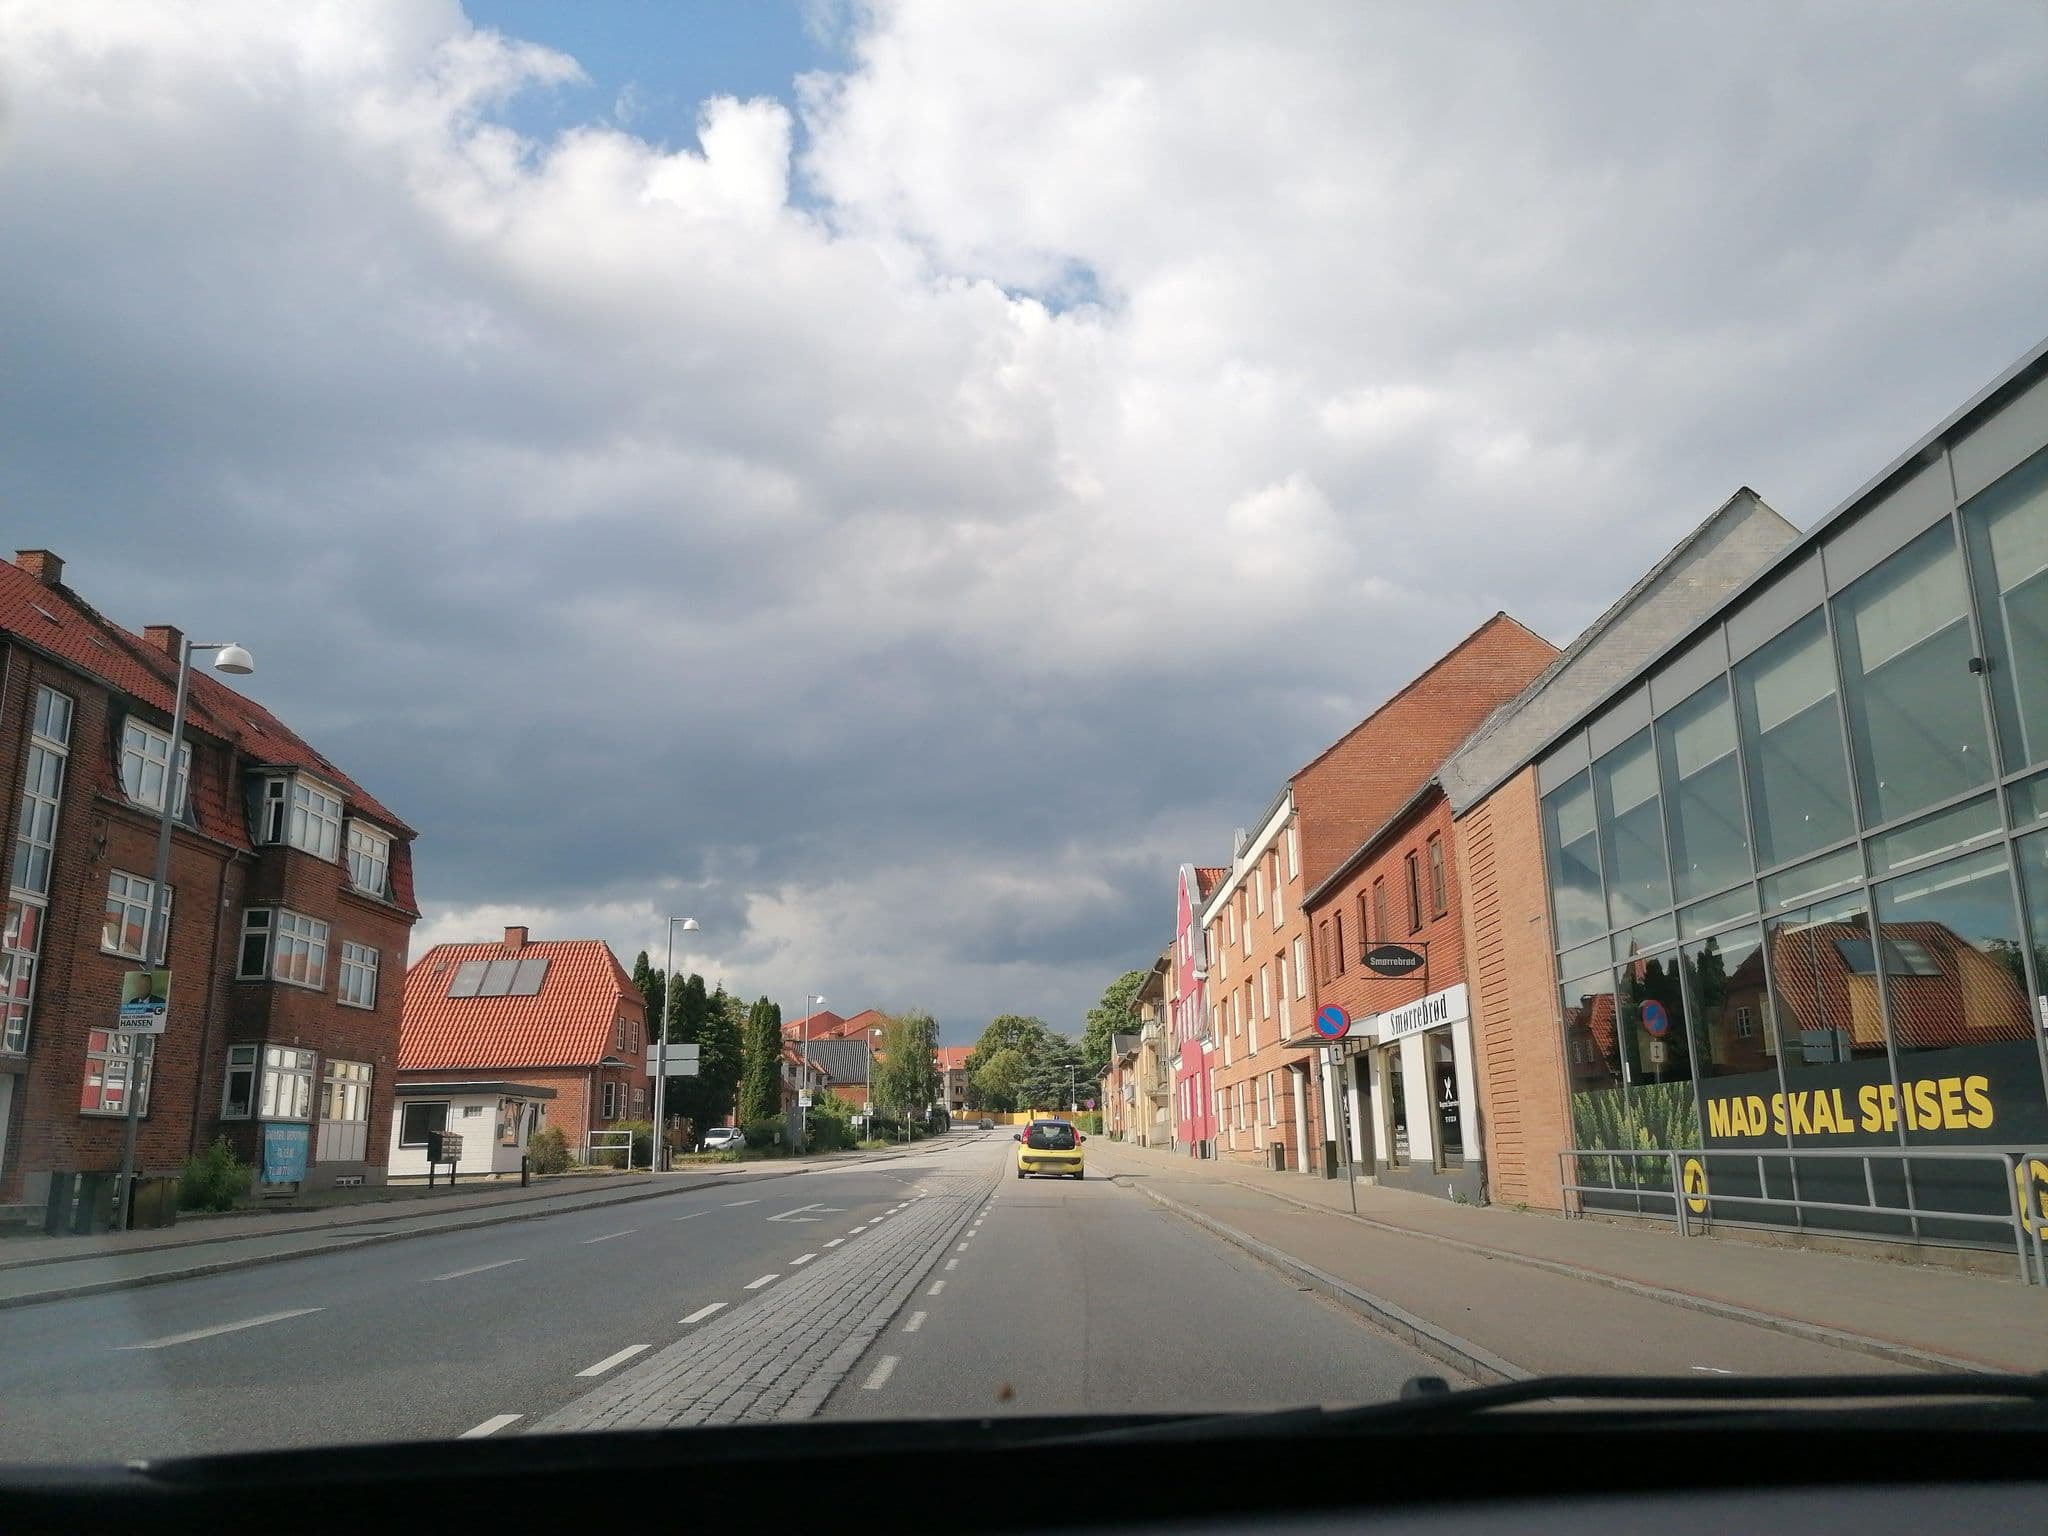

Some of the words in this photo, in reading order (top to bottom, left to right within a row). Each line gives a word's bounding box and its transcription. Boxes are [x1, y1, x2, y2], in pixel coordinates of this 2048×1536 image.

[1370, 957, 1416, 966] Smørrebrød
[120, 1019, 153, 1027] HANSEN
[1390, 993, 1448, 1036] Smørrebrød
[1707, 1095, 1767, 1137] MAD
[1771, 1088, 1855, 1136] SKAL
[1858, 1075, 1994, 1133] SPISES
